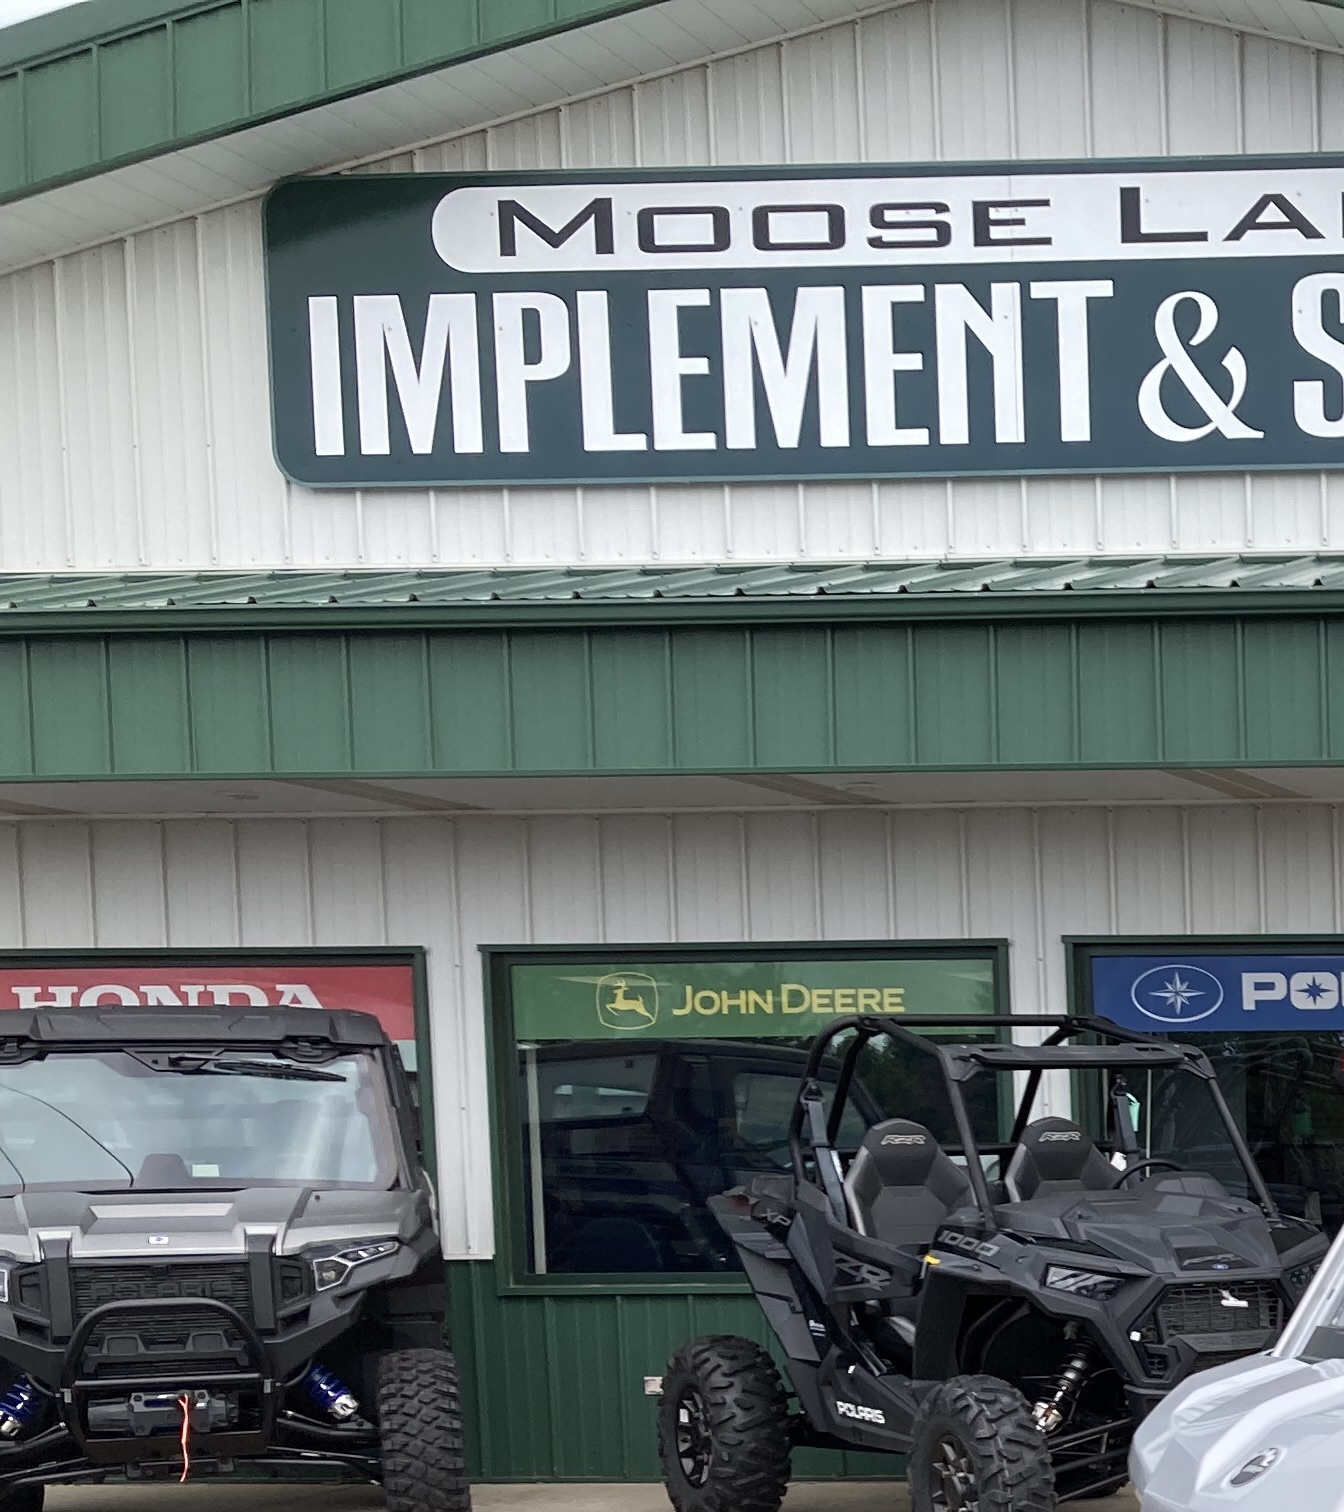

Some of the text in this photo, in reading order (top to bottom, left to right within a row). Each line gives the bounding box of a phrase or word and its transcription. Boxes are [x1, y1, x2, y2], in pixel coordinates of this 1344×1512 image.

[497, 196, 1053, 257] MOOSE
[306, 278, 1114, 456] IMPLEMENT
[1137, 290, 1265, 443] &
[672, 983, 906, 1016] JOHN DEERE
[760, 1207, 792, 1227] XP
[937, 1228, 1001, 1257] 1000
[835, 1401, 885, 1424] POLARIS
